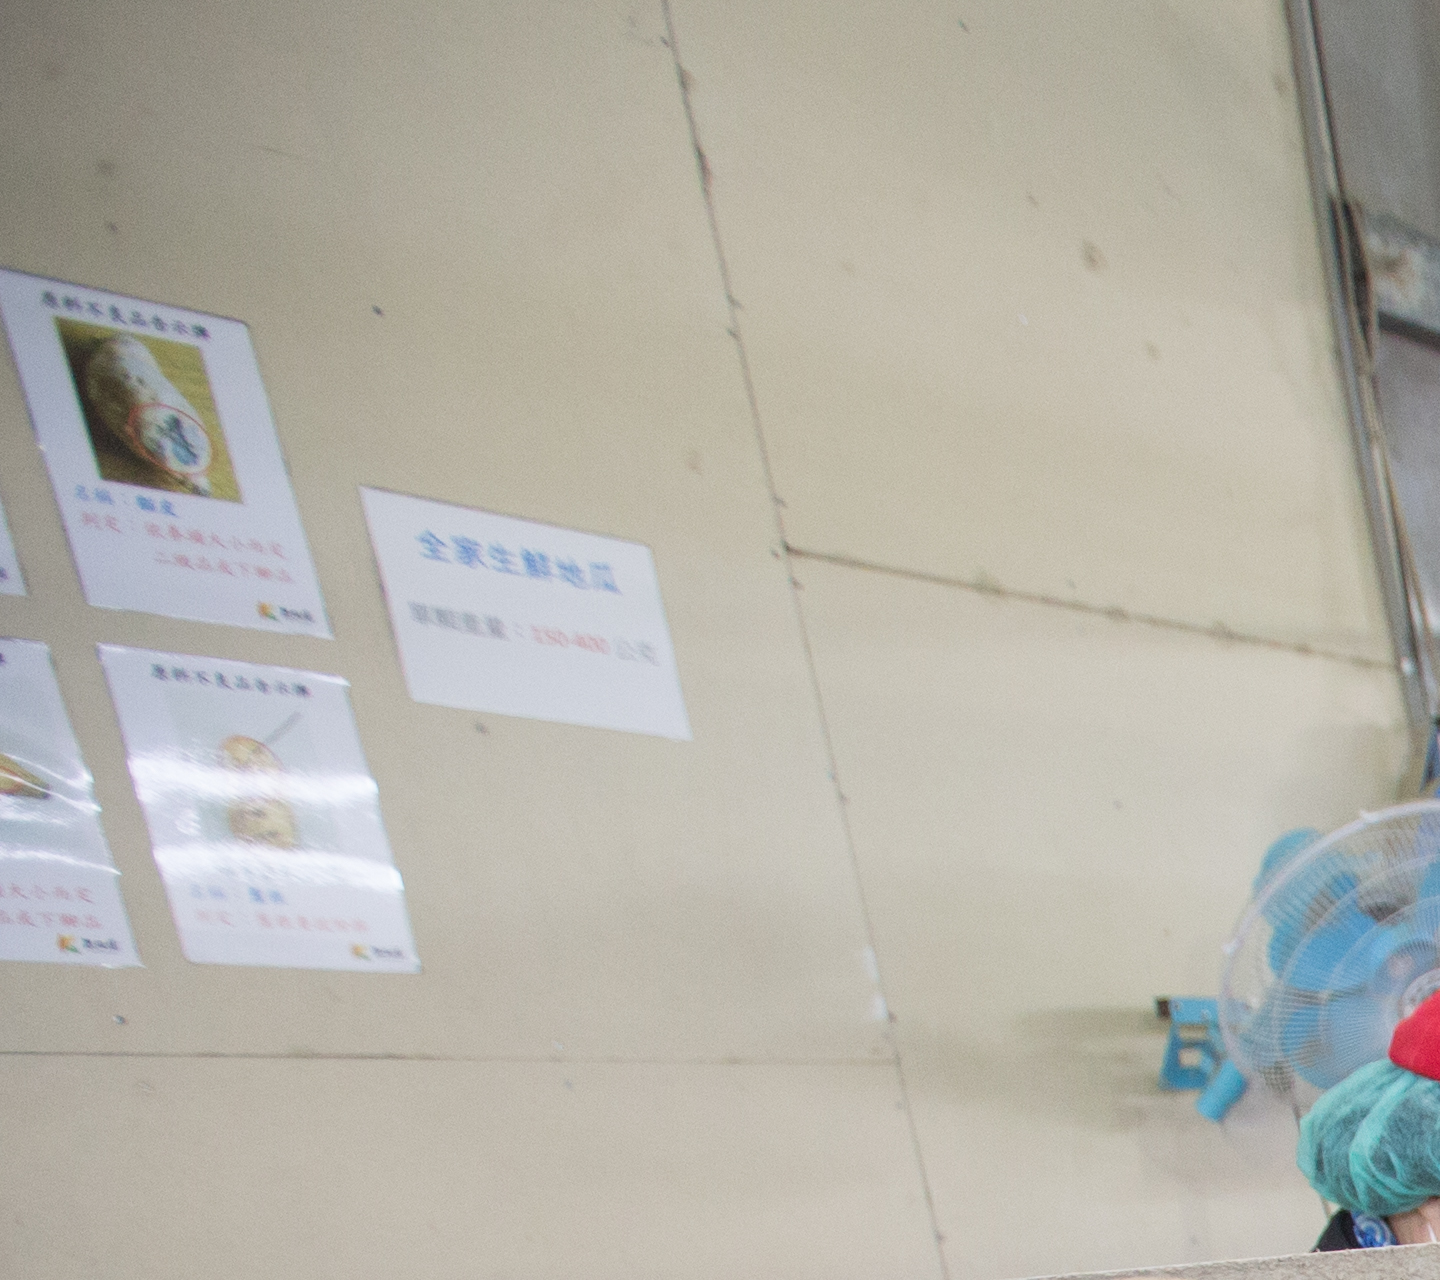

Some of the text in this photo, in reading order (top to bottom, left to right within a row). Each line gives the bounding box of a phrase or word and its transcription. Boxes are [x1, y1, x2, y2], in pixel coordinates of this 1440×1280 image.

[413, 529, 623, 596] 全家生鮮地瓜
